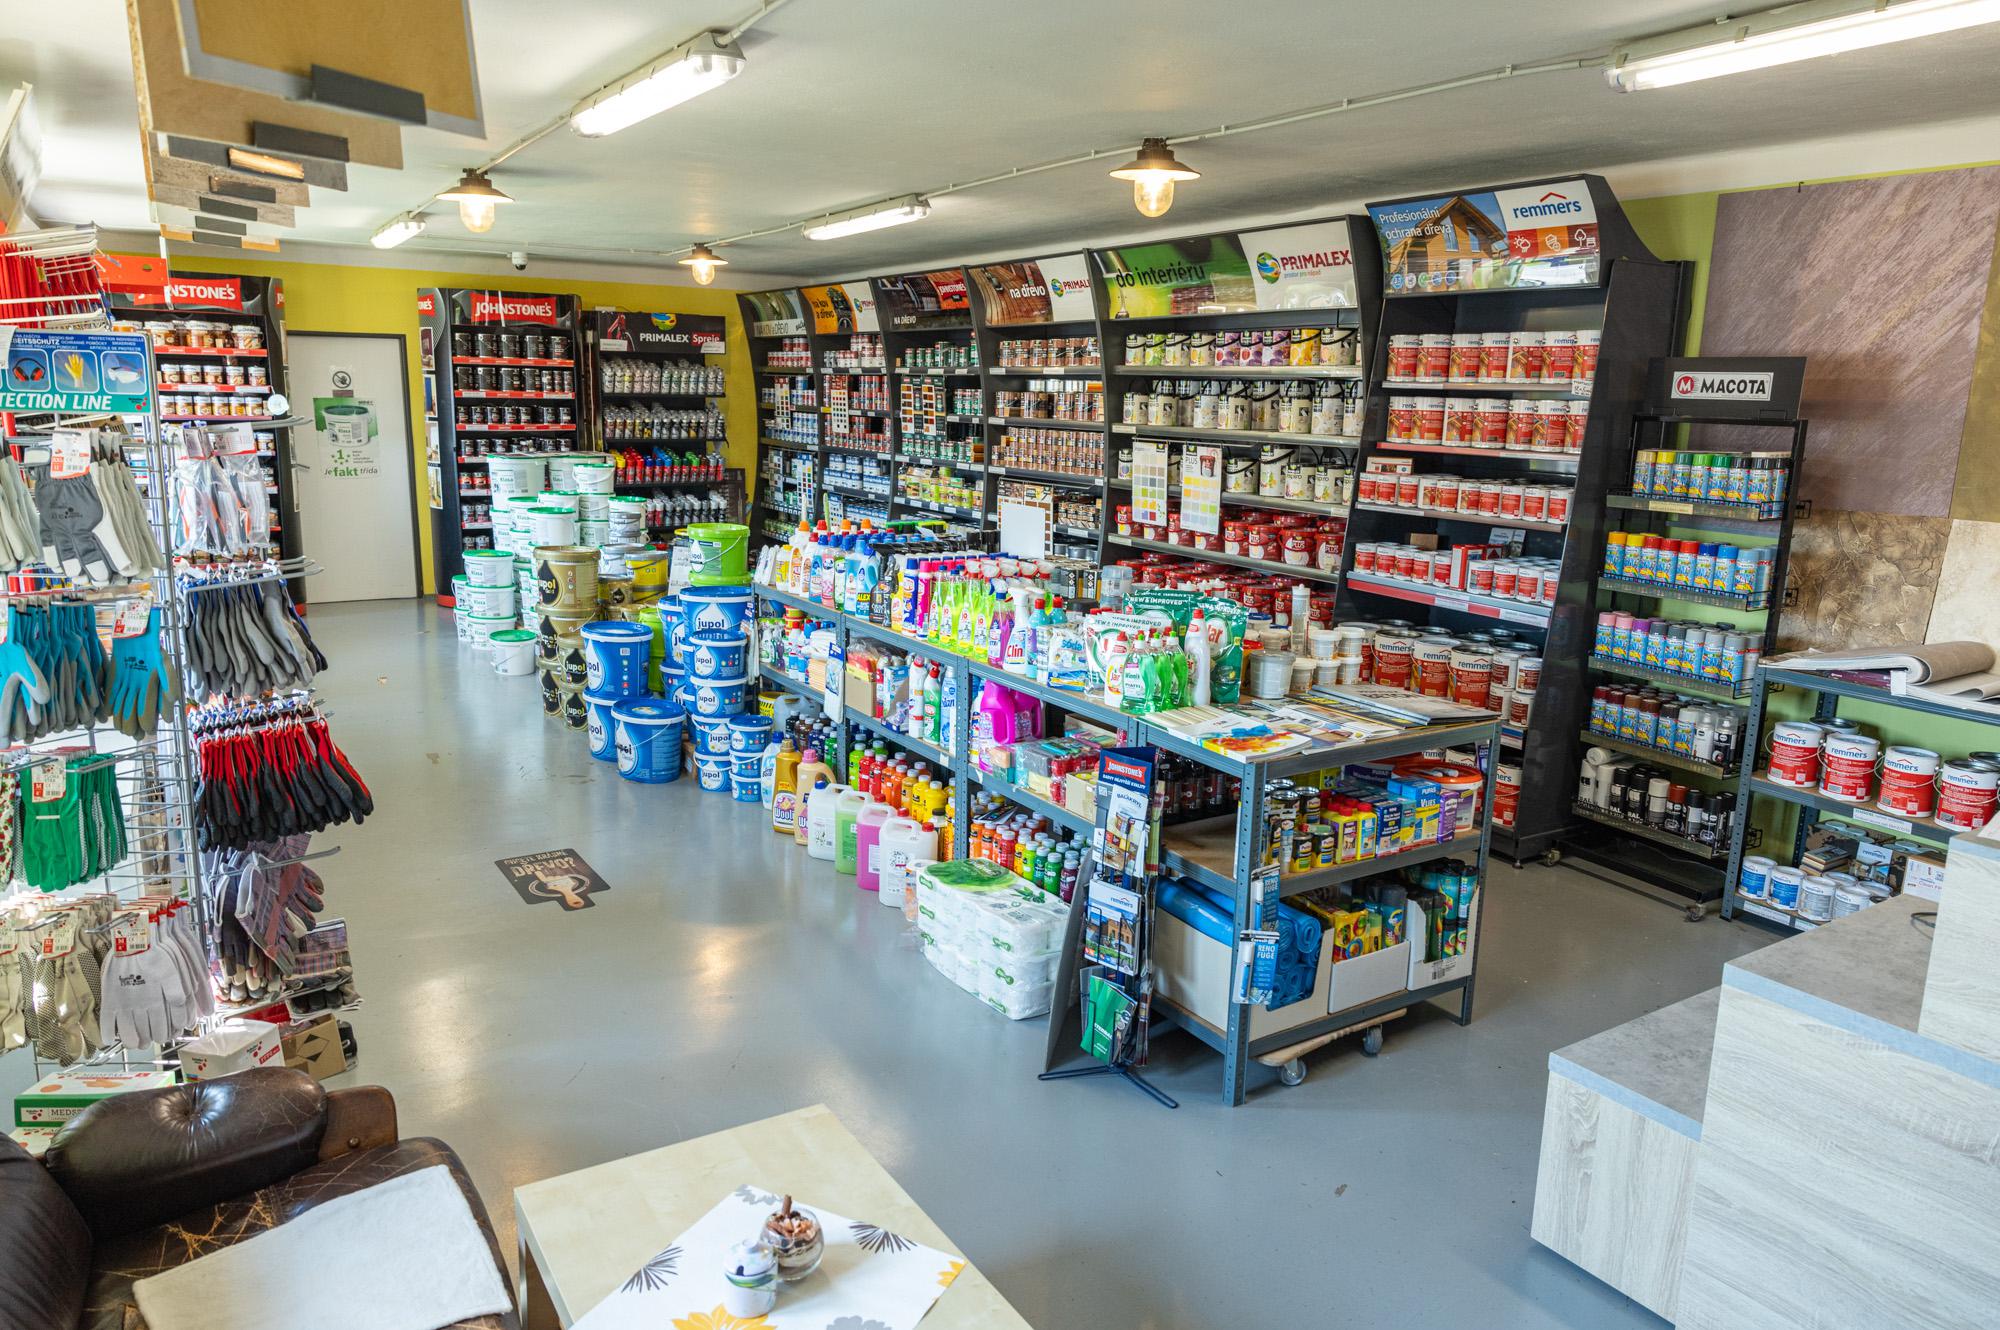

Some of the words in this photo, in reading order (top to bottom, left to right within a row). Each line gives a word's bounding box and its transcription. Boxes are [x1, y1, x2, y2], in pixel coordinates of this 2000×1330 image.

[1513, 199, 1582, 219] remmers
[1379, 207, 1441, 224] Profesionální
[1386, 223, 1422, 240] ochrana
[1424, 221, 1452, 236] dřeva
[1280, 249, 1352, 271] PRIMALEX
[1116, 266, 1134, 288] do
[1135, 262, 1206, 287] interiéru
[1064, 279, 1090, 290] PRIMAL
[170, 284, 236, 300] NSTONE'S
[1010, 288, 1021, 299] na
[1022, 283, 1046, 297] dřevo
[475, 301, 552, 317] JOHNSTONE'S
[640, 332, 689, 343] PRIMALEX
[1700, 378, 1766, 394] MACOTA
[73, 395, 112, 410] LINE
[1186, 456, 1198, 464] PLUS
[333, 466, 358, 476] fakt
[857, 592, 870, 602] ALEX
[1150, 598, 1184, 606] IMPROVED
[698, 618, 725, 630] jupol
[1130, 619, 1162, 627] IMPROVED
[1007, 644, 1023, 658] Clin
[1379, 643, 1411, 652] remmers
[695, 656, 712, 666] jupol
[1423, 652, 1450, 662] remm
[566, 660, 586, 673] jupol
[1458, 661, 1492, 670] remmers
[698, 694, 716, 705] jupol
[566, 704, 584, 716] jupol
[710, 733, 730, 744] jupol
[1776, 734, 1806, 745] remmers
[1831, 748, 1868, 758] remmers
[1108, 762, 1142, 778] JOHNSTONE'S
[702, 771, 720, 781] jupol
[1948, 774, 1978, 786] remmers
[774, 806, 794, 820] Wool
[1258, 944, 1276, 952] RENO
[1257, 952, 1275, 960] FUGE
